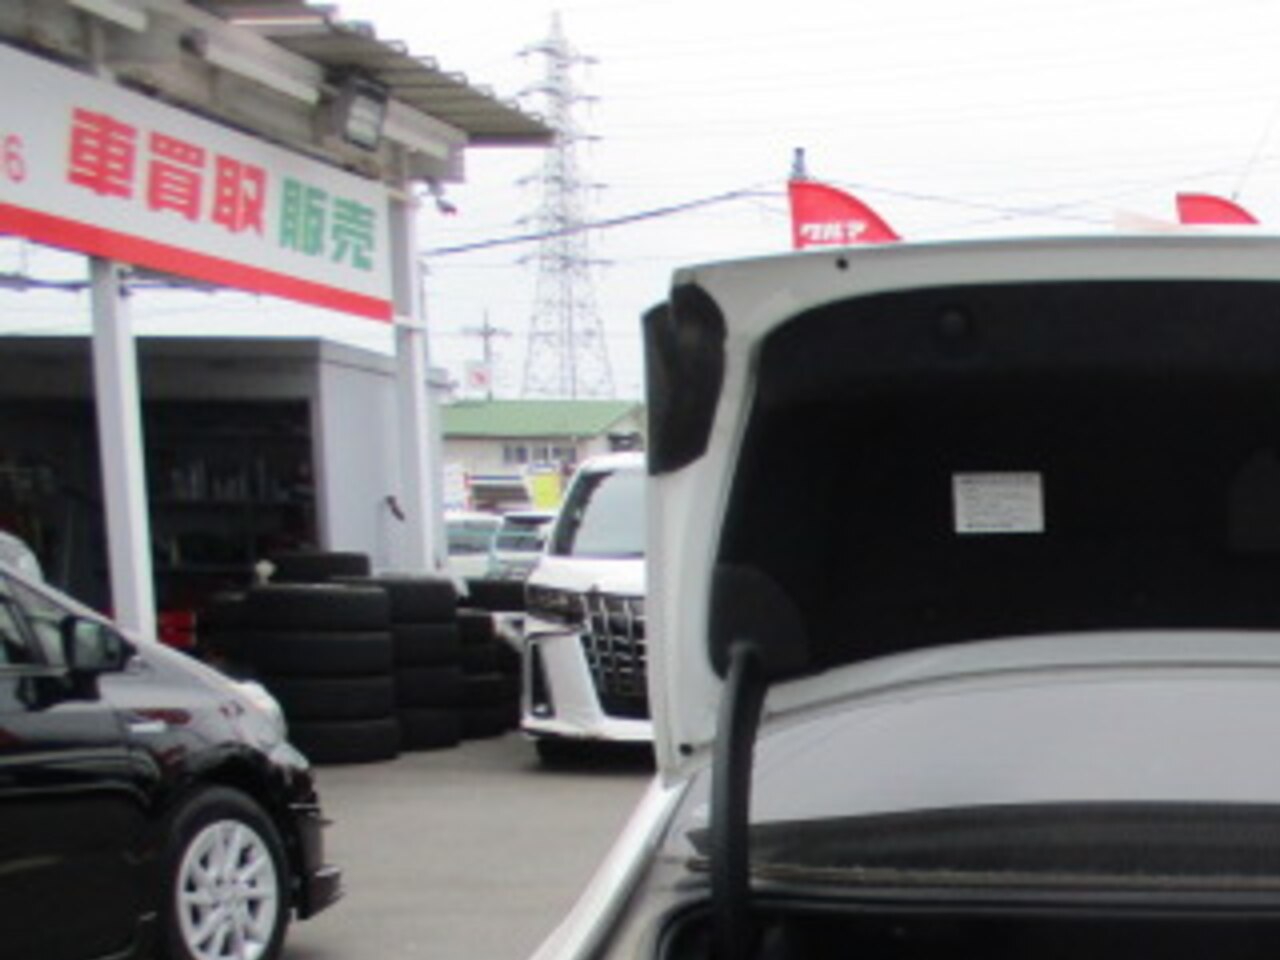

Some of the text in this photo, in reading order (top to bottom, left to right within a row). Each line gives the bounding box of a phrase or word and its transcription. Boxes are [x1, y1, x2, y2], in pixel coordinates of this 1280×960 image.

[67, 106, 377, 272] 車買取 販売
